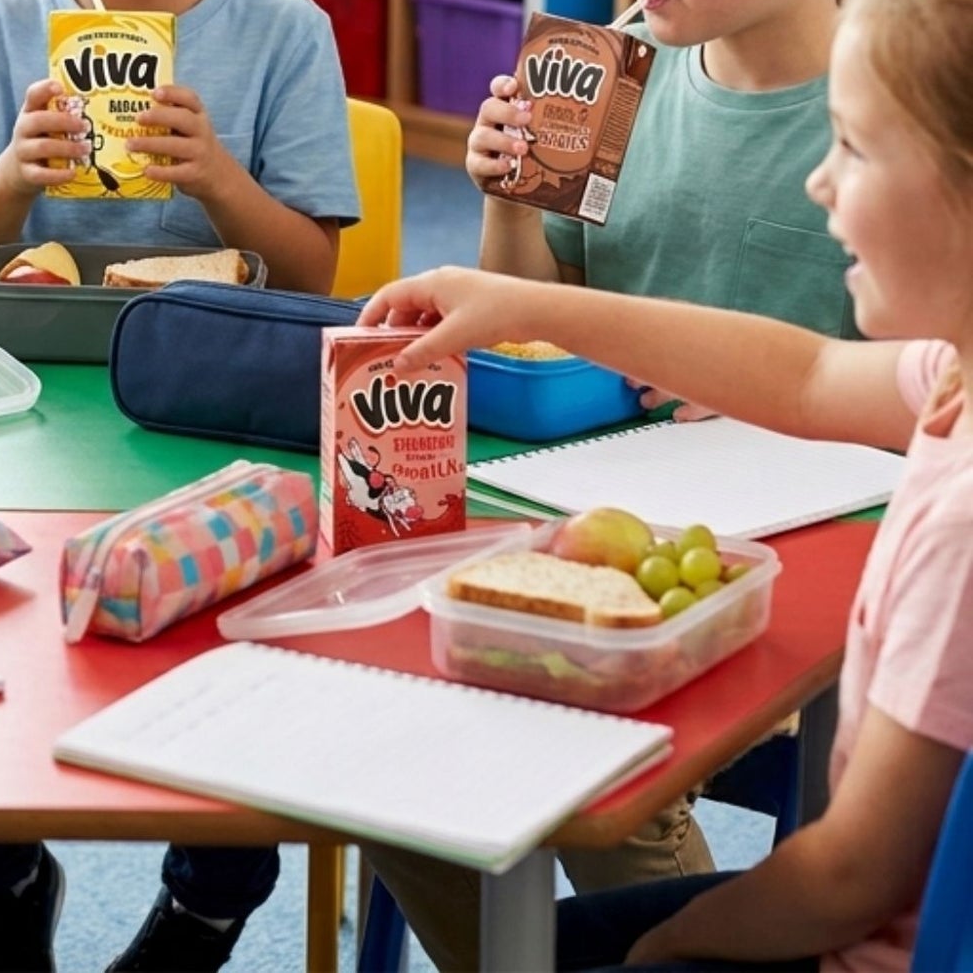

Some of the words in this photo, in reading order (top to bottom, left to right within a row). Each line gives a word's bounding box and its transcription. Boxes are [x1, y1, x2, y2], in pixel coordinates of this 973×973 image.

[64, 44, 159, 92] Viva
[527, 48, 604, 103] Viva
[353, 374, 455, 431] Viva
